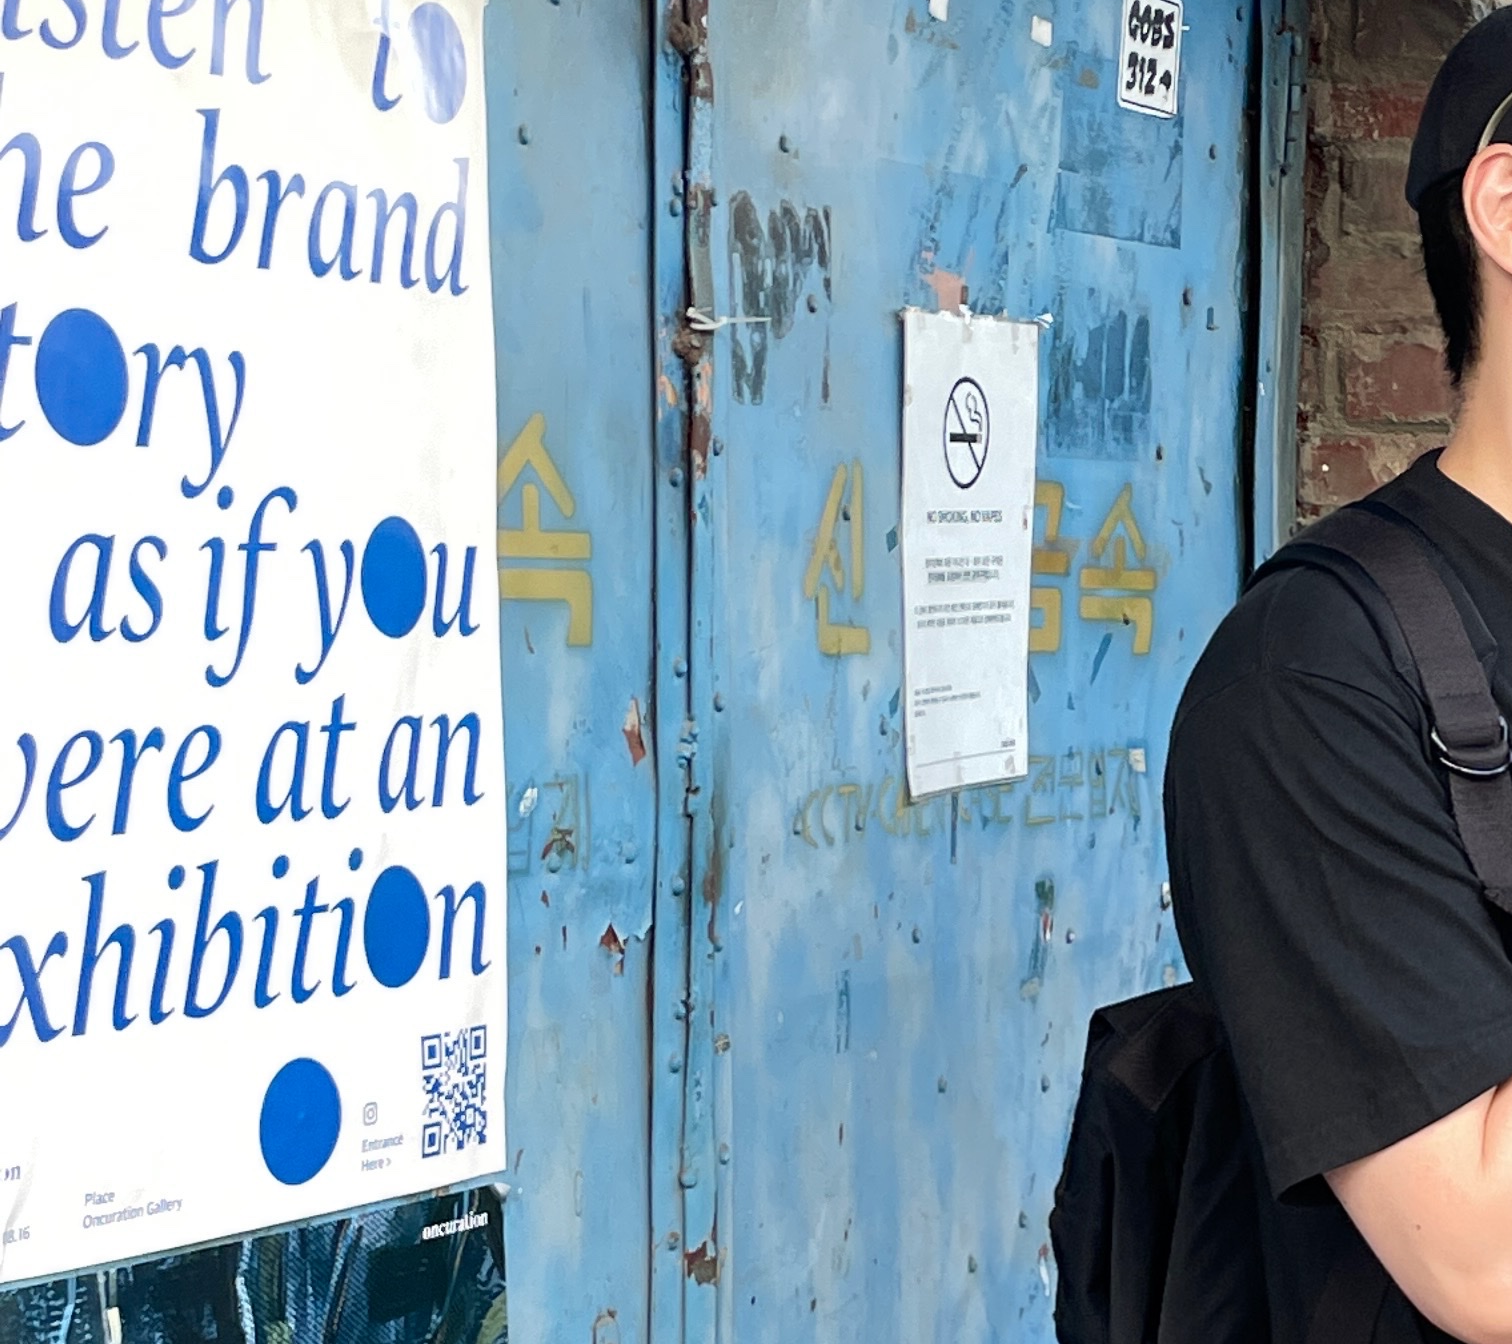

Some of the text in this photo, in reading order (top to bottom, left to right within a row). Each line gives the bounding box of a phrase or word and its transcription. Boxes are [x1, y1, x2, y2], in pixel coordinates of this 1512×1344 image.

[189, 108, 469, 296] brand
[48, 485, 480, 689] as if you
[255, 694, 357, 825] at
[378, 711, 485, 814] an
[361, 1134, 404, 1172] Entrance Here
[83, 1198, 183, 1229] Oncuration Gallery
[84, 1191, 115, 1206] Place
[422, 1211, 489, 1240] oncuration
